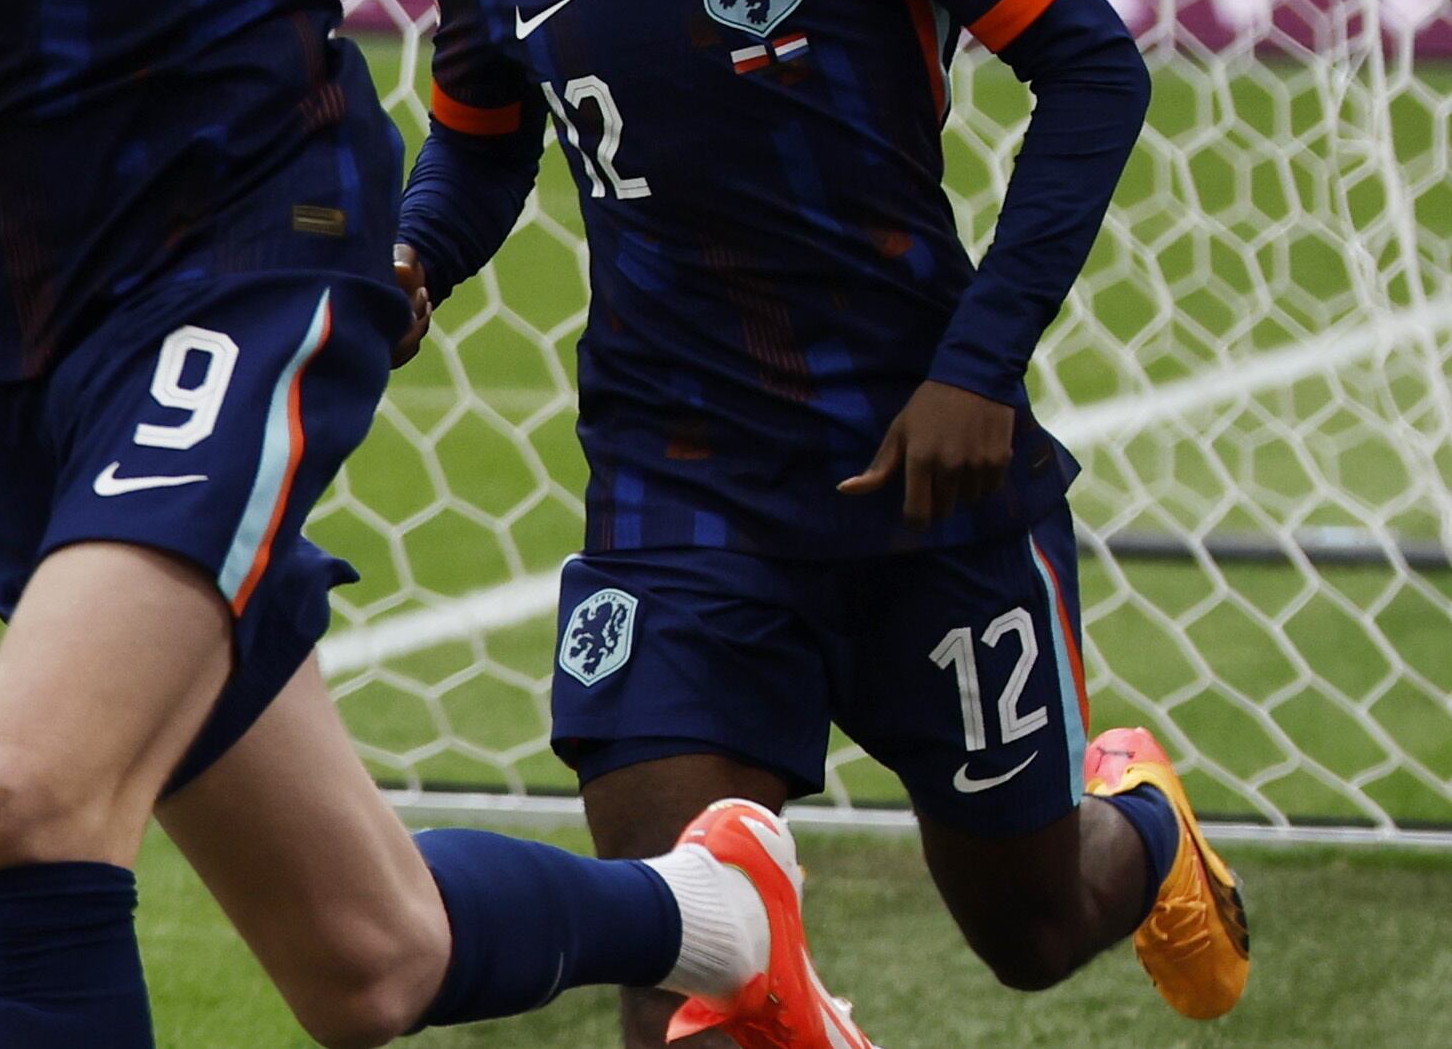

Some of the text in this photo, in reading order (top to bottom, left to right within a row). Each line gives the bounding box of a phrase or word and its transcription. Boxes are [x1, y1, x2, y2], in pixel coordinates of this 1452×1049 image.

[540, 75, 652, 201] 12
[132, 324, 239, 451] 9
[928, 606, 1050, 753] 12
